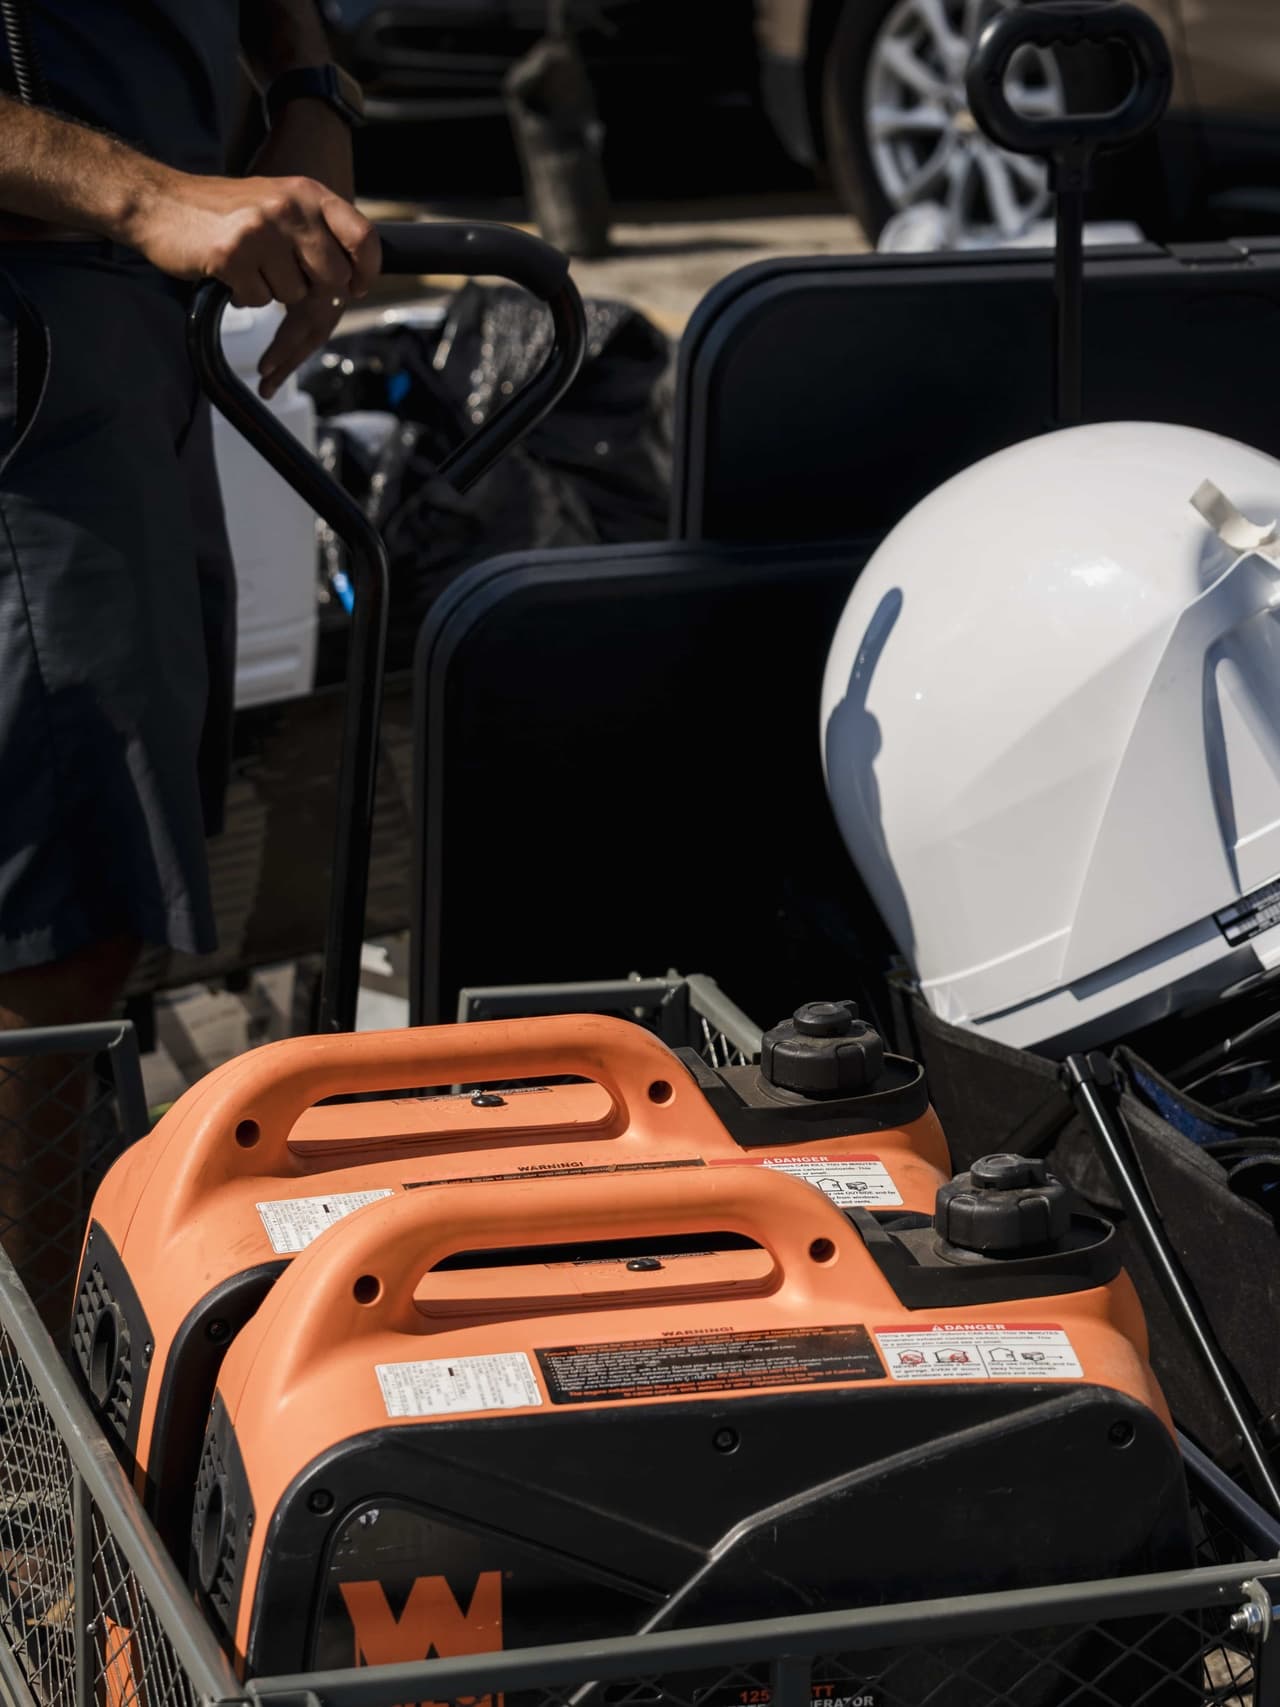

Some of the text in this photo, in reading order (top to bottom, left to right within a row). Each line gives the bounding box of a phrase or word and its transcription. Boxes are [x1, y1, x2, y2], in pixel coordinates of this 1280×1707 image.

[774, 1156, 829, 1164] DANGER
[517, 1161, 584, 1171] WARNING!
[661, 1326, 734, 1337] WARNING!
